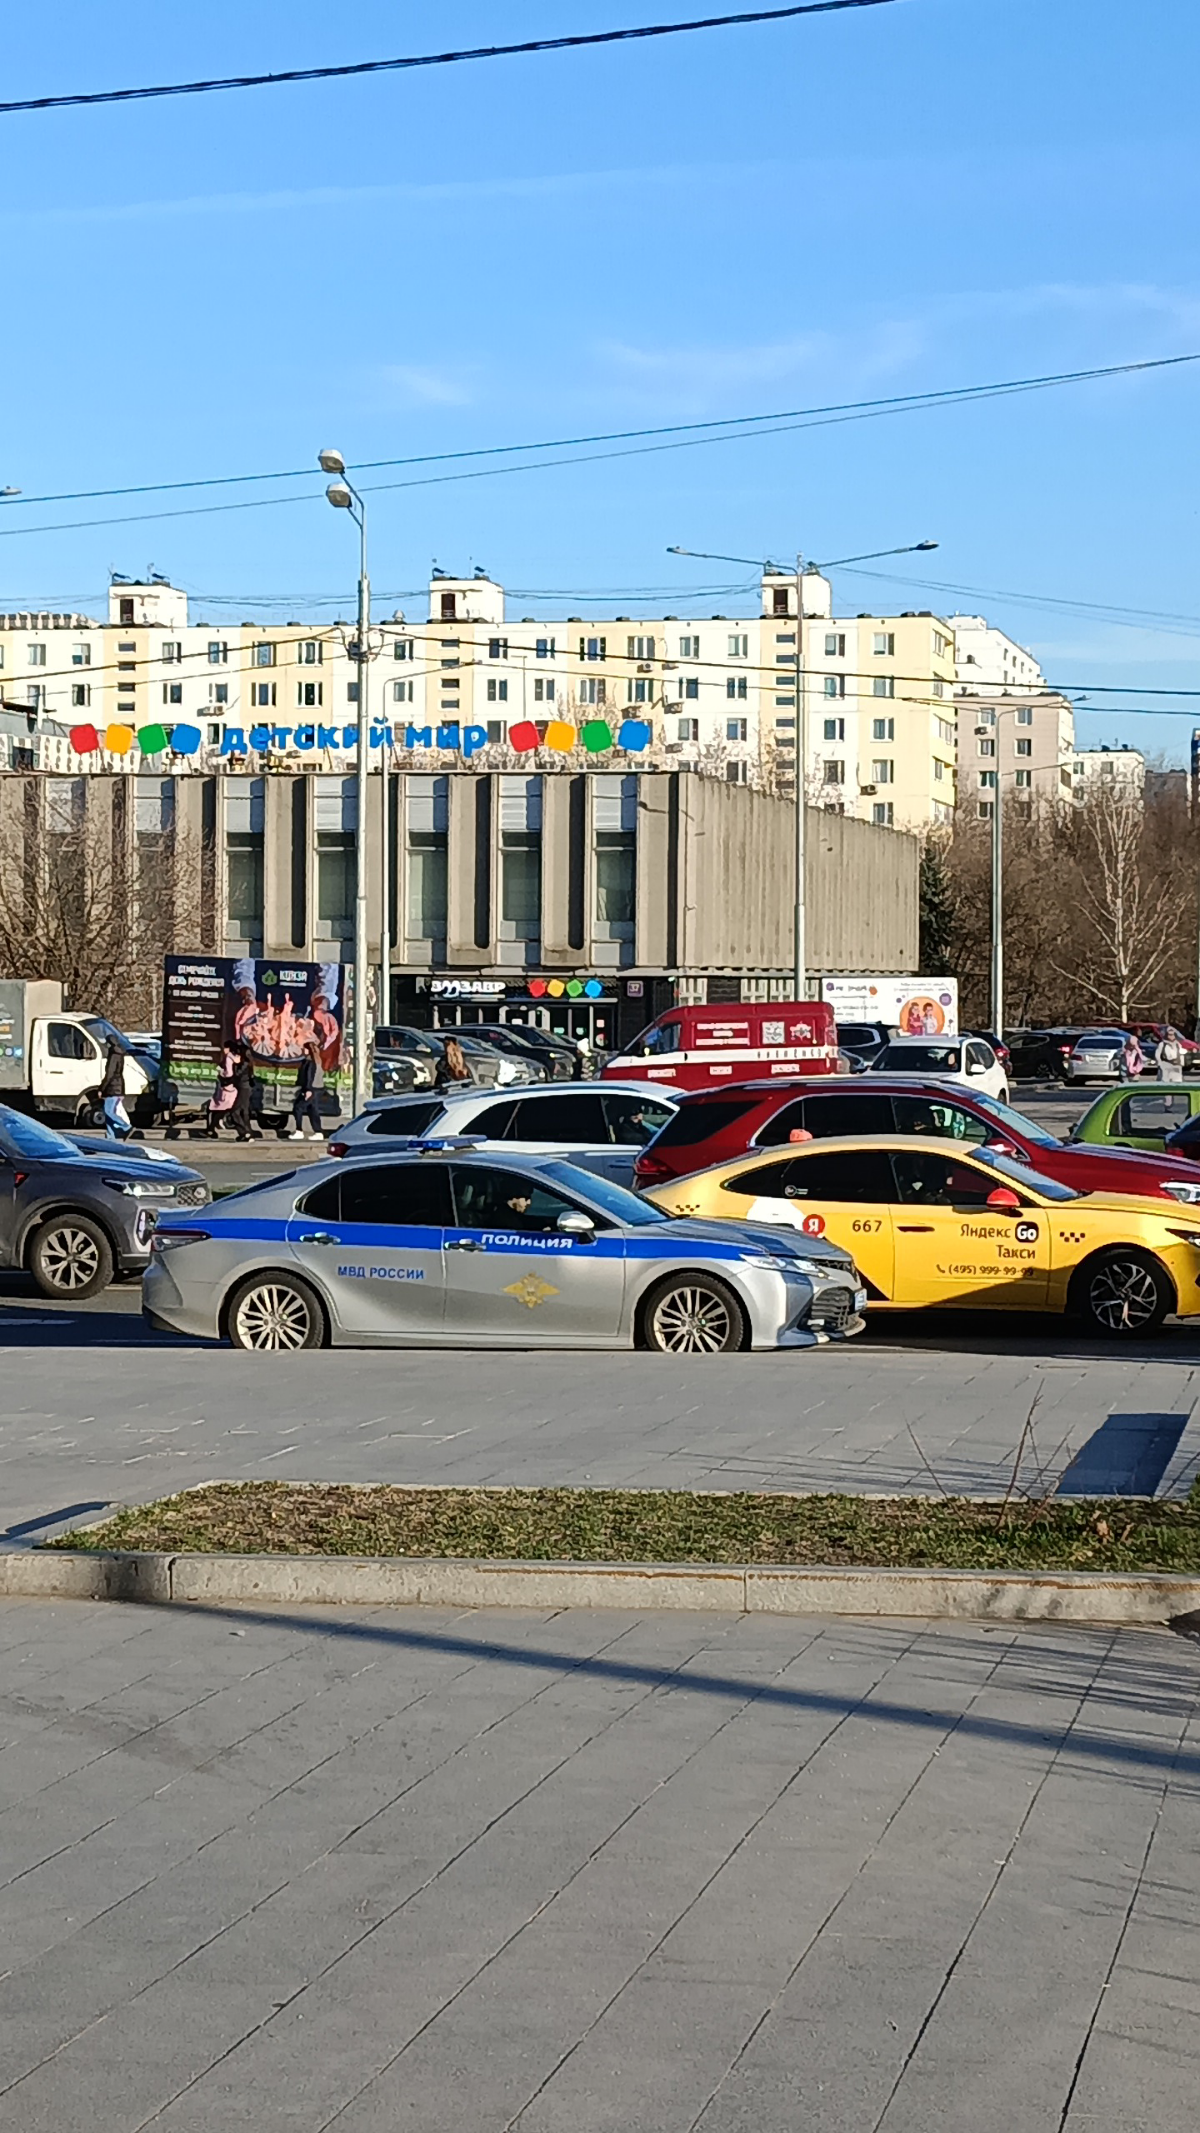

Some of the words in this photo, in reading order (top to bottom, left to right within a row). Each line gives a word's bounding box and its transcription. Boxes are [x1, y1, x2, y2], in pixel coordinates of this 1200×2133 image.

[221, 716, 393, 755] детский
[405, 724, 488, 758] мир
[808, 1218, 819, 1233] Я
[852, 1220, 882, 1233] 667
[960, 1223, 1011, 1239] Яндекс
[1016, 1225, 1037, 1241] Go
[481, 1233, 573, 1249] ПОЛИЦИЯ
[996, 1244, 1036, 1260] Такси
[337, 1266, 366, 1278] МВД
[369, 1266, 424, 1280] РОССИИ
[948, 1264, 977, 1276] (495)
